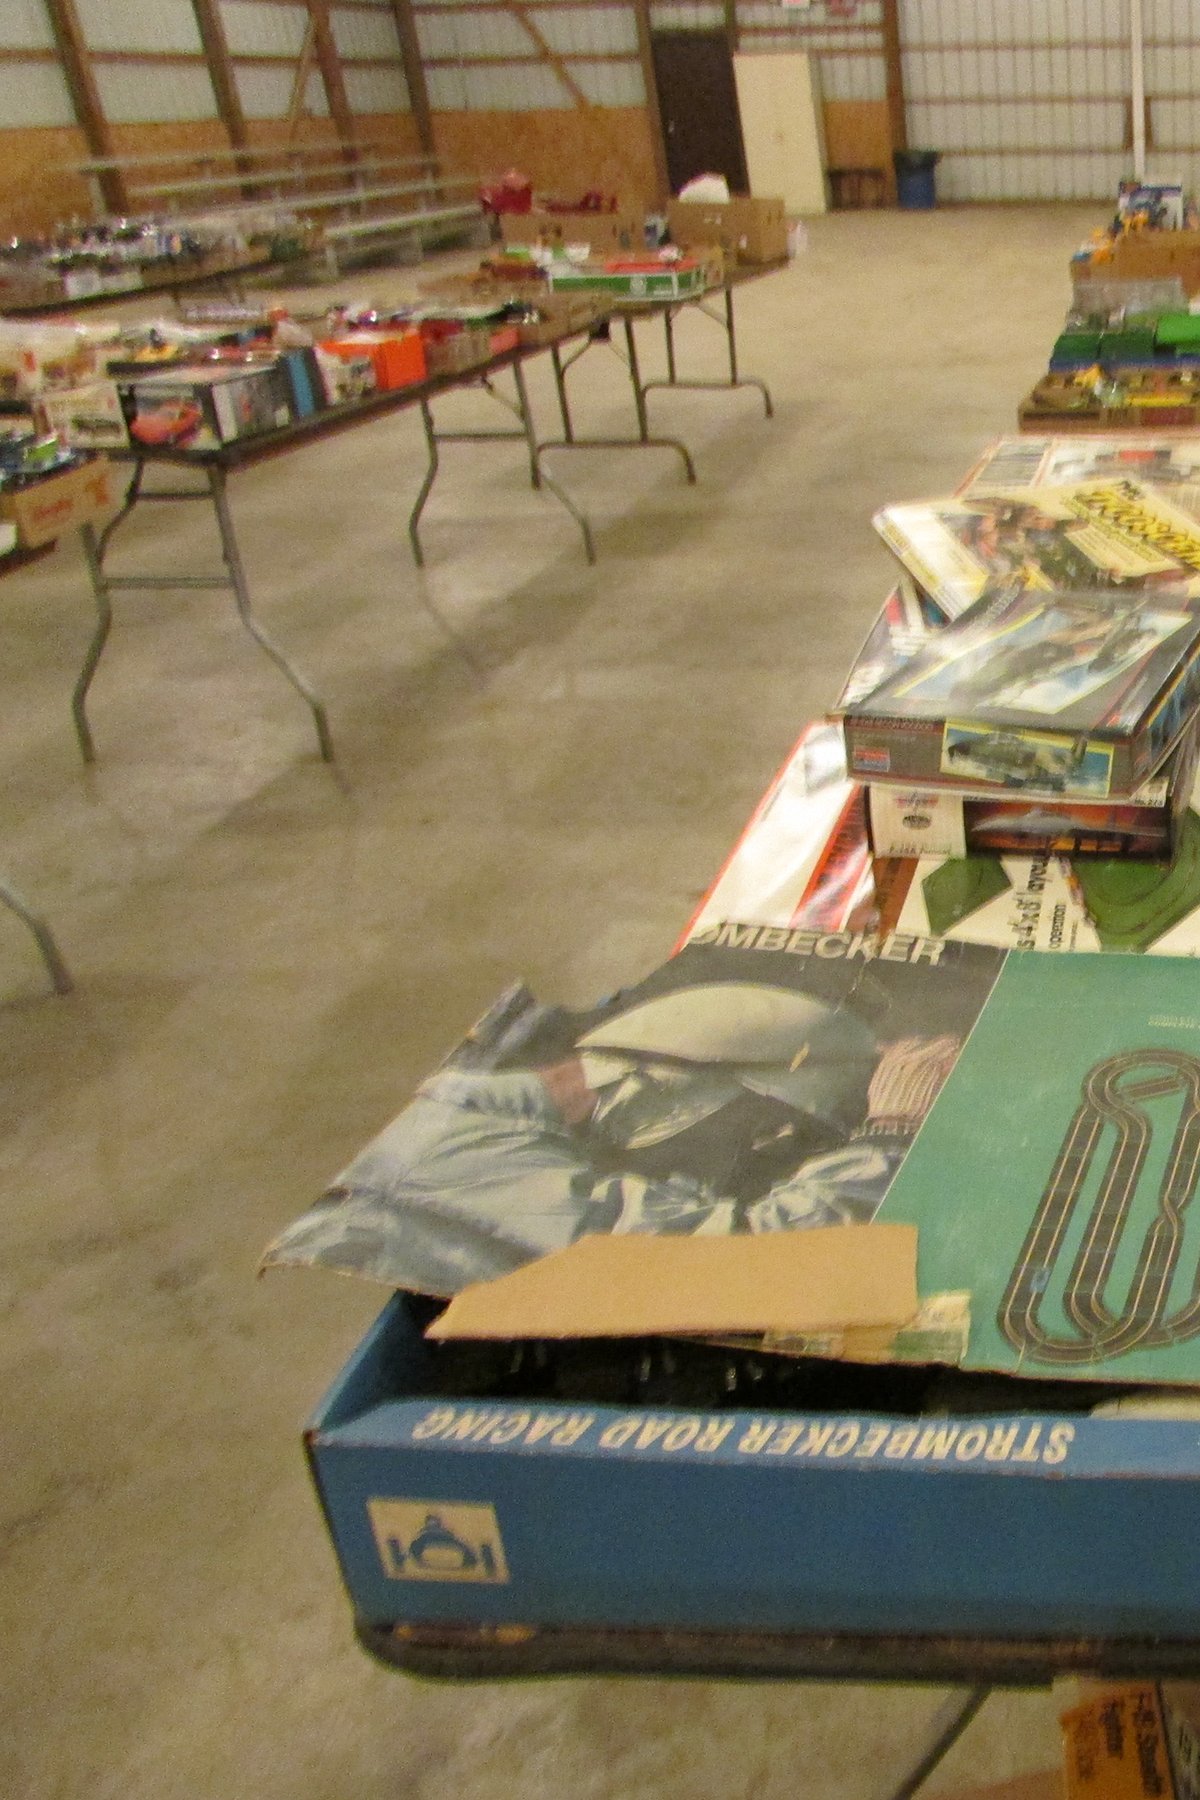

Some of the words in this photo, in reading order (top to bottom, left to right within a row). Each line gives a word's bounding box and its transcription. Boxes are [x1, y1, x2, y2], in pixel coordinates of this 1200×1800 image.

[690, 923, 945, 966] OMBECKER
[411, 1407, 597, 1446] RACING
[599, 1413, 735, 1451] ROAD
[738, 1418, 1075, 1464] STROMBECKER
